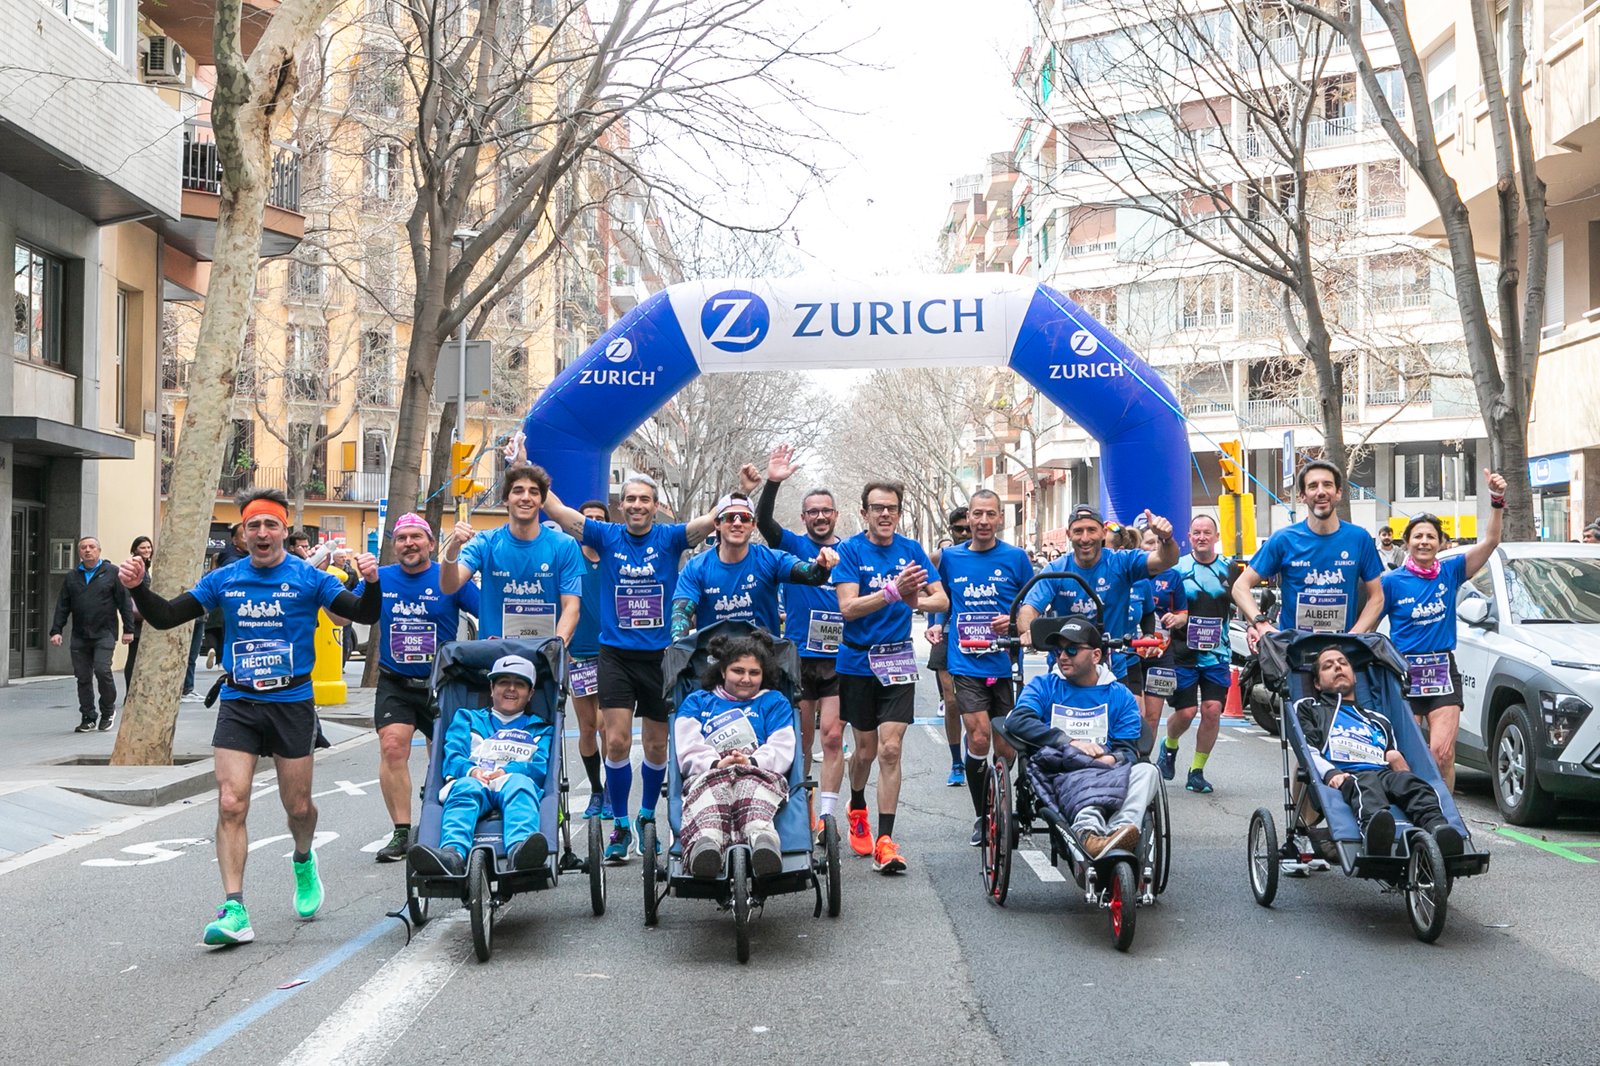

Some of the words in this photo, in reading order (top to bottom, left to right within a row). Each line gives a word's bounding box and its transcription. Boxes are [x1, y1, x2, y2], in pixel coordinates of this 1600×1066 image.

[792, 298, 985, 338] ZURICH
[1048, 362, 1124, 379] ZURICH
[578, 369, 656, 386] ZURICH
[628, 598, 651, 609] RAÚL
[1304, 609, 1340, 619] ALBERT
[964, 625, 991, 635] OCHOA
[1196, 628, 1215, 636] ANDY
[402, 635, 423, 645] JOSE
[241, 654, 283, 669] HÉCTOR
[871, 660, 895, 669] CARLOS
[1154, 679, 1173, 687] BECKY
[712, 715, 732, 727] ZURICH
[713, 727, 738, 745] LOLA
[491, 744, 531, 756] ALVARO
